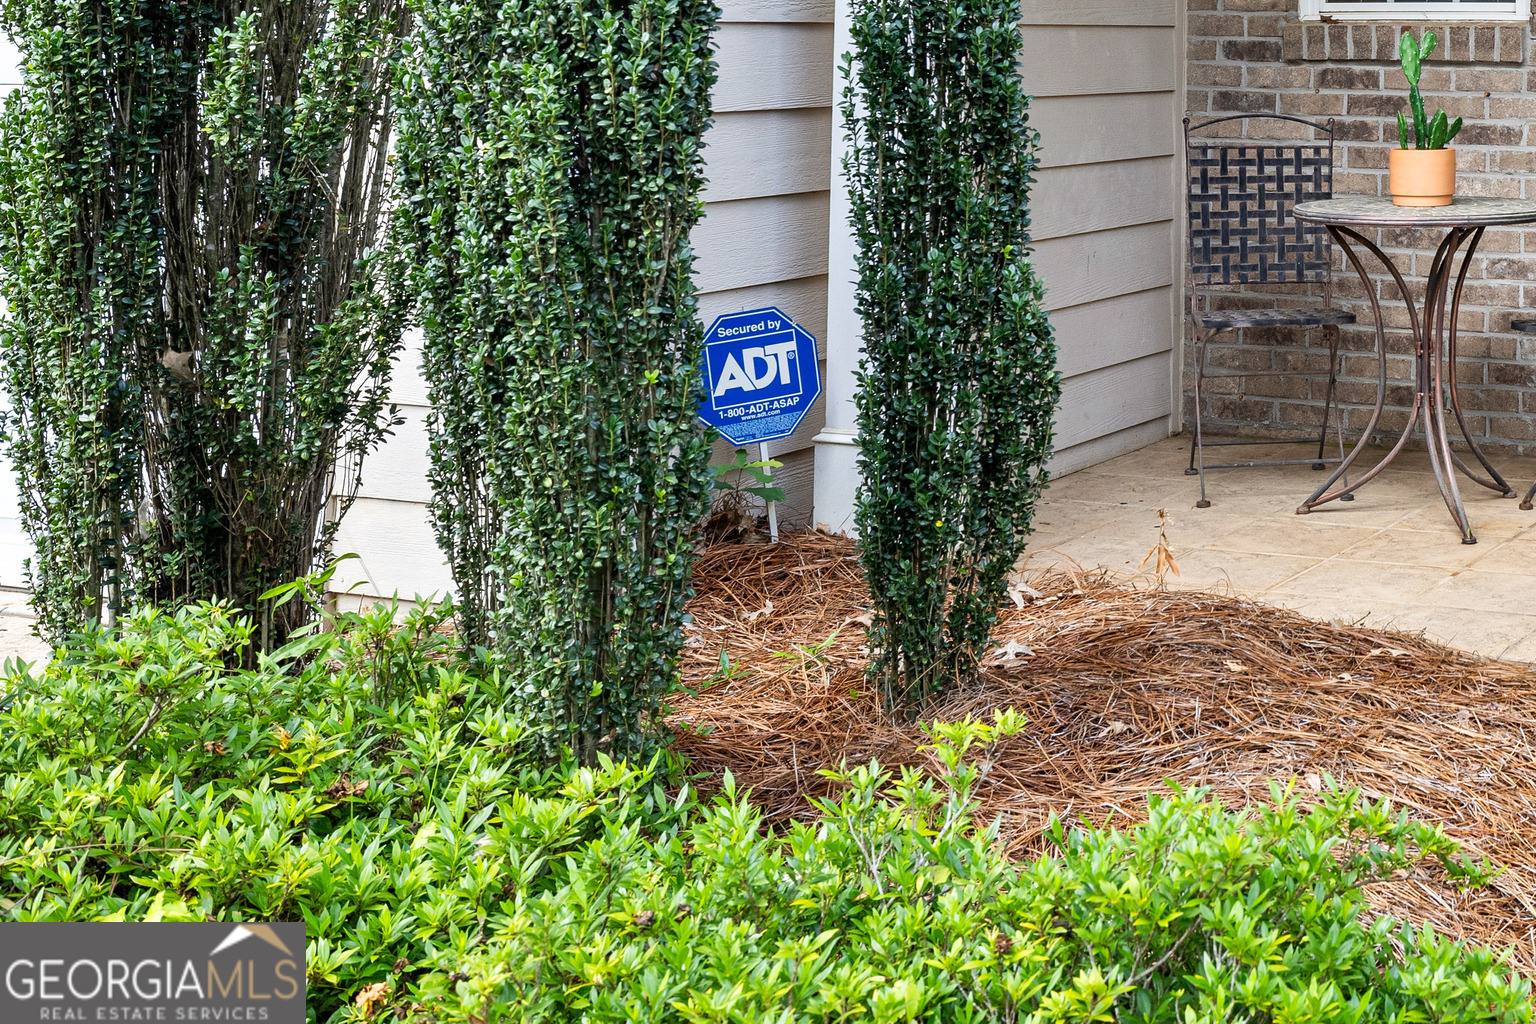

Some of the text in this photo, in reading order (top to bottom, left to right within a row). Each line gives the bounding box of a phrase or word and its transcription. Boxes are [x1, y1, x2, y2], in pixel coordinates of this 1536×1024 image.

[717, 319, 781, 338] Secured by
[713, 340, 796, 397] ADT
[718, 396, 800, 419] 1-800-ADT-ASAP
[741, 409, 780, 421] www.adt.com
